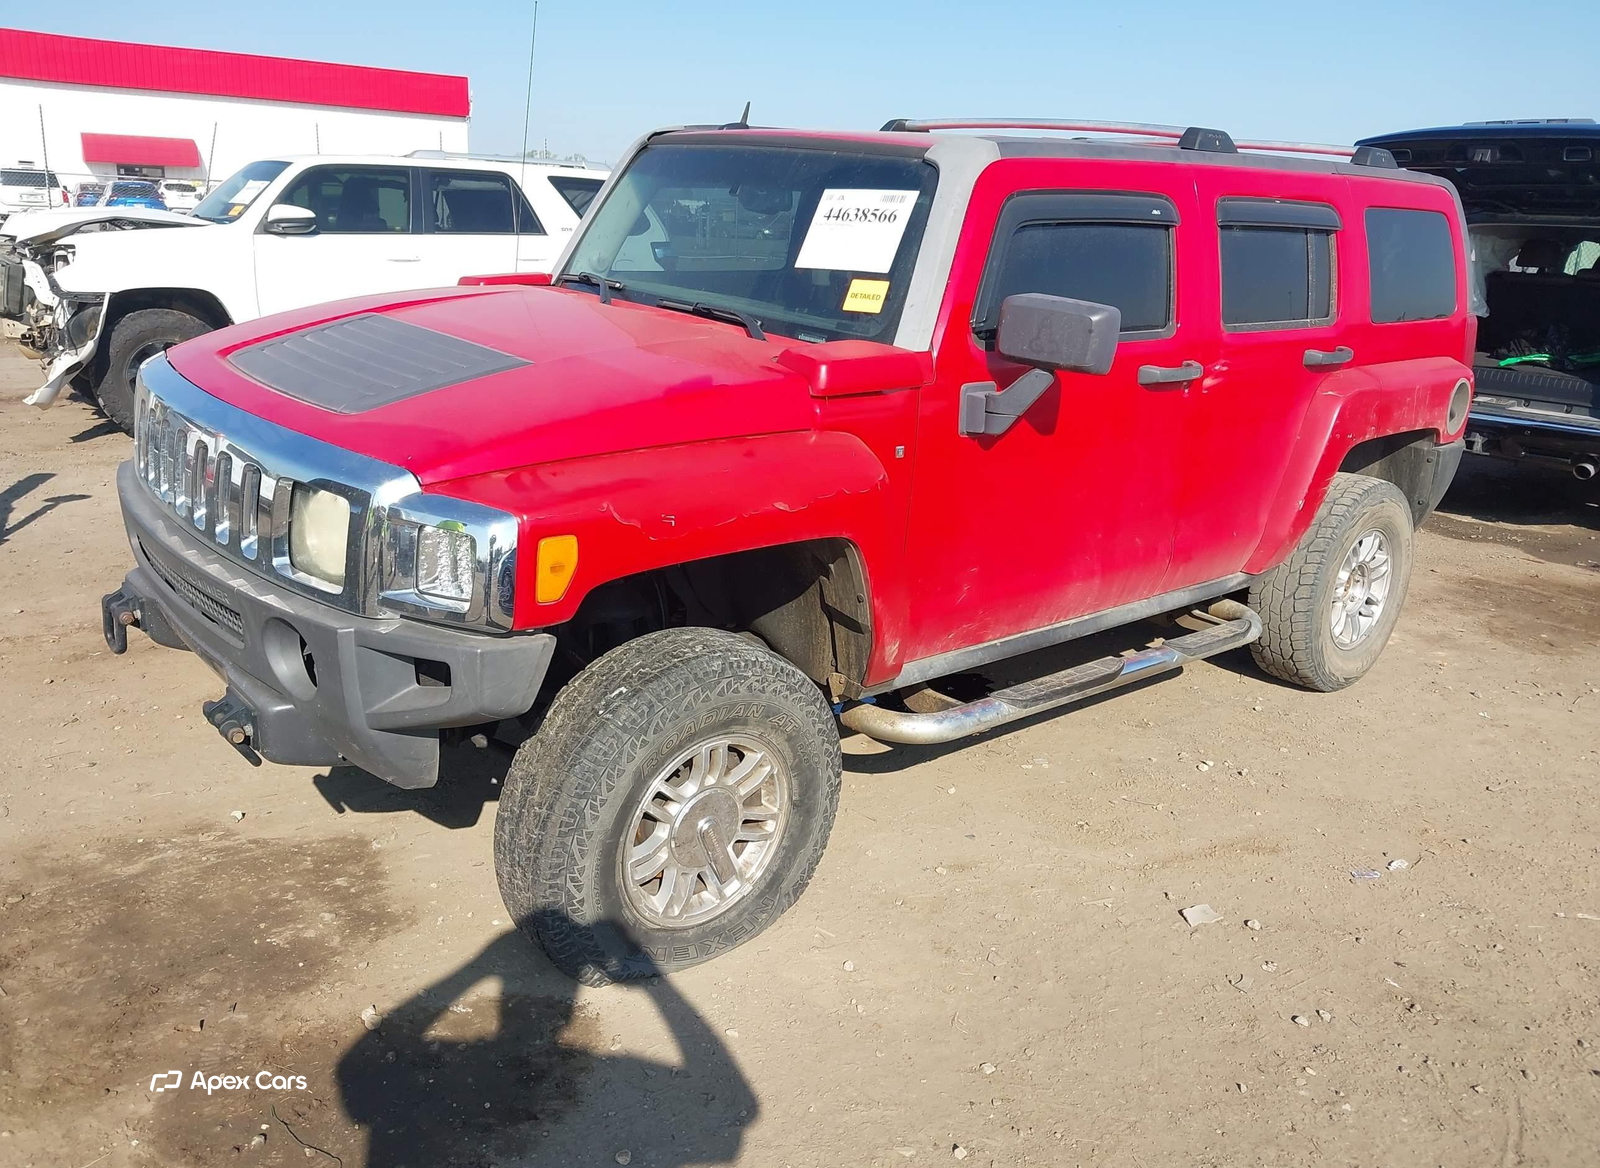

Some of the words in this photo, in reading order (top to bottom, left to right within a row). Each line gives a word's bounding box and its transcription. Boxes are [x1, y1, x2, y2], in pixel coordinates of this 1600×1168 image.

[823, 207, 898, 223] 44638566
[849, 292, 882, 301] DETAILED
[640, 703, 767, 780] ROADIAN
[768, 713, 800, 734] AT
[625, 896, 776, 962] NEXEN
